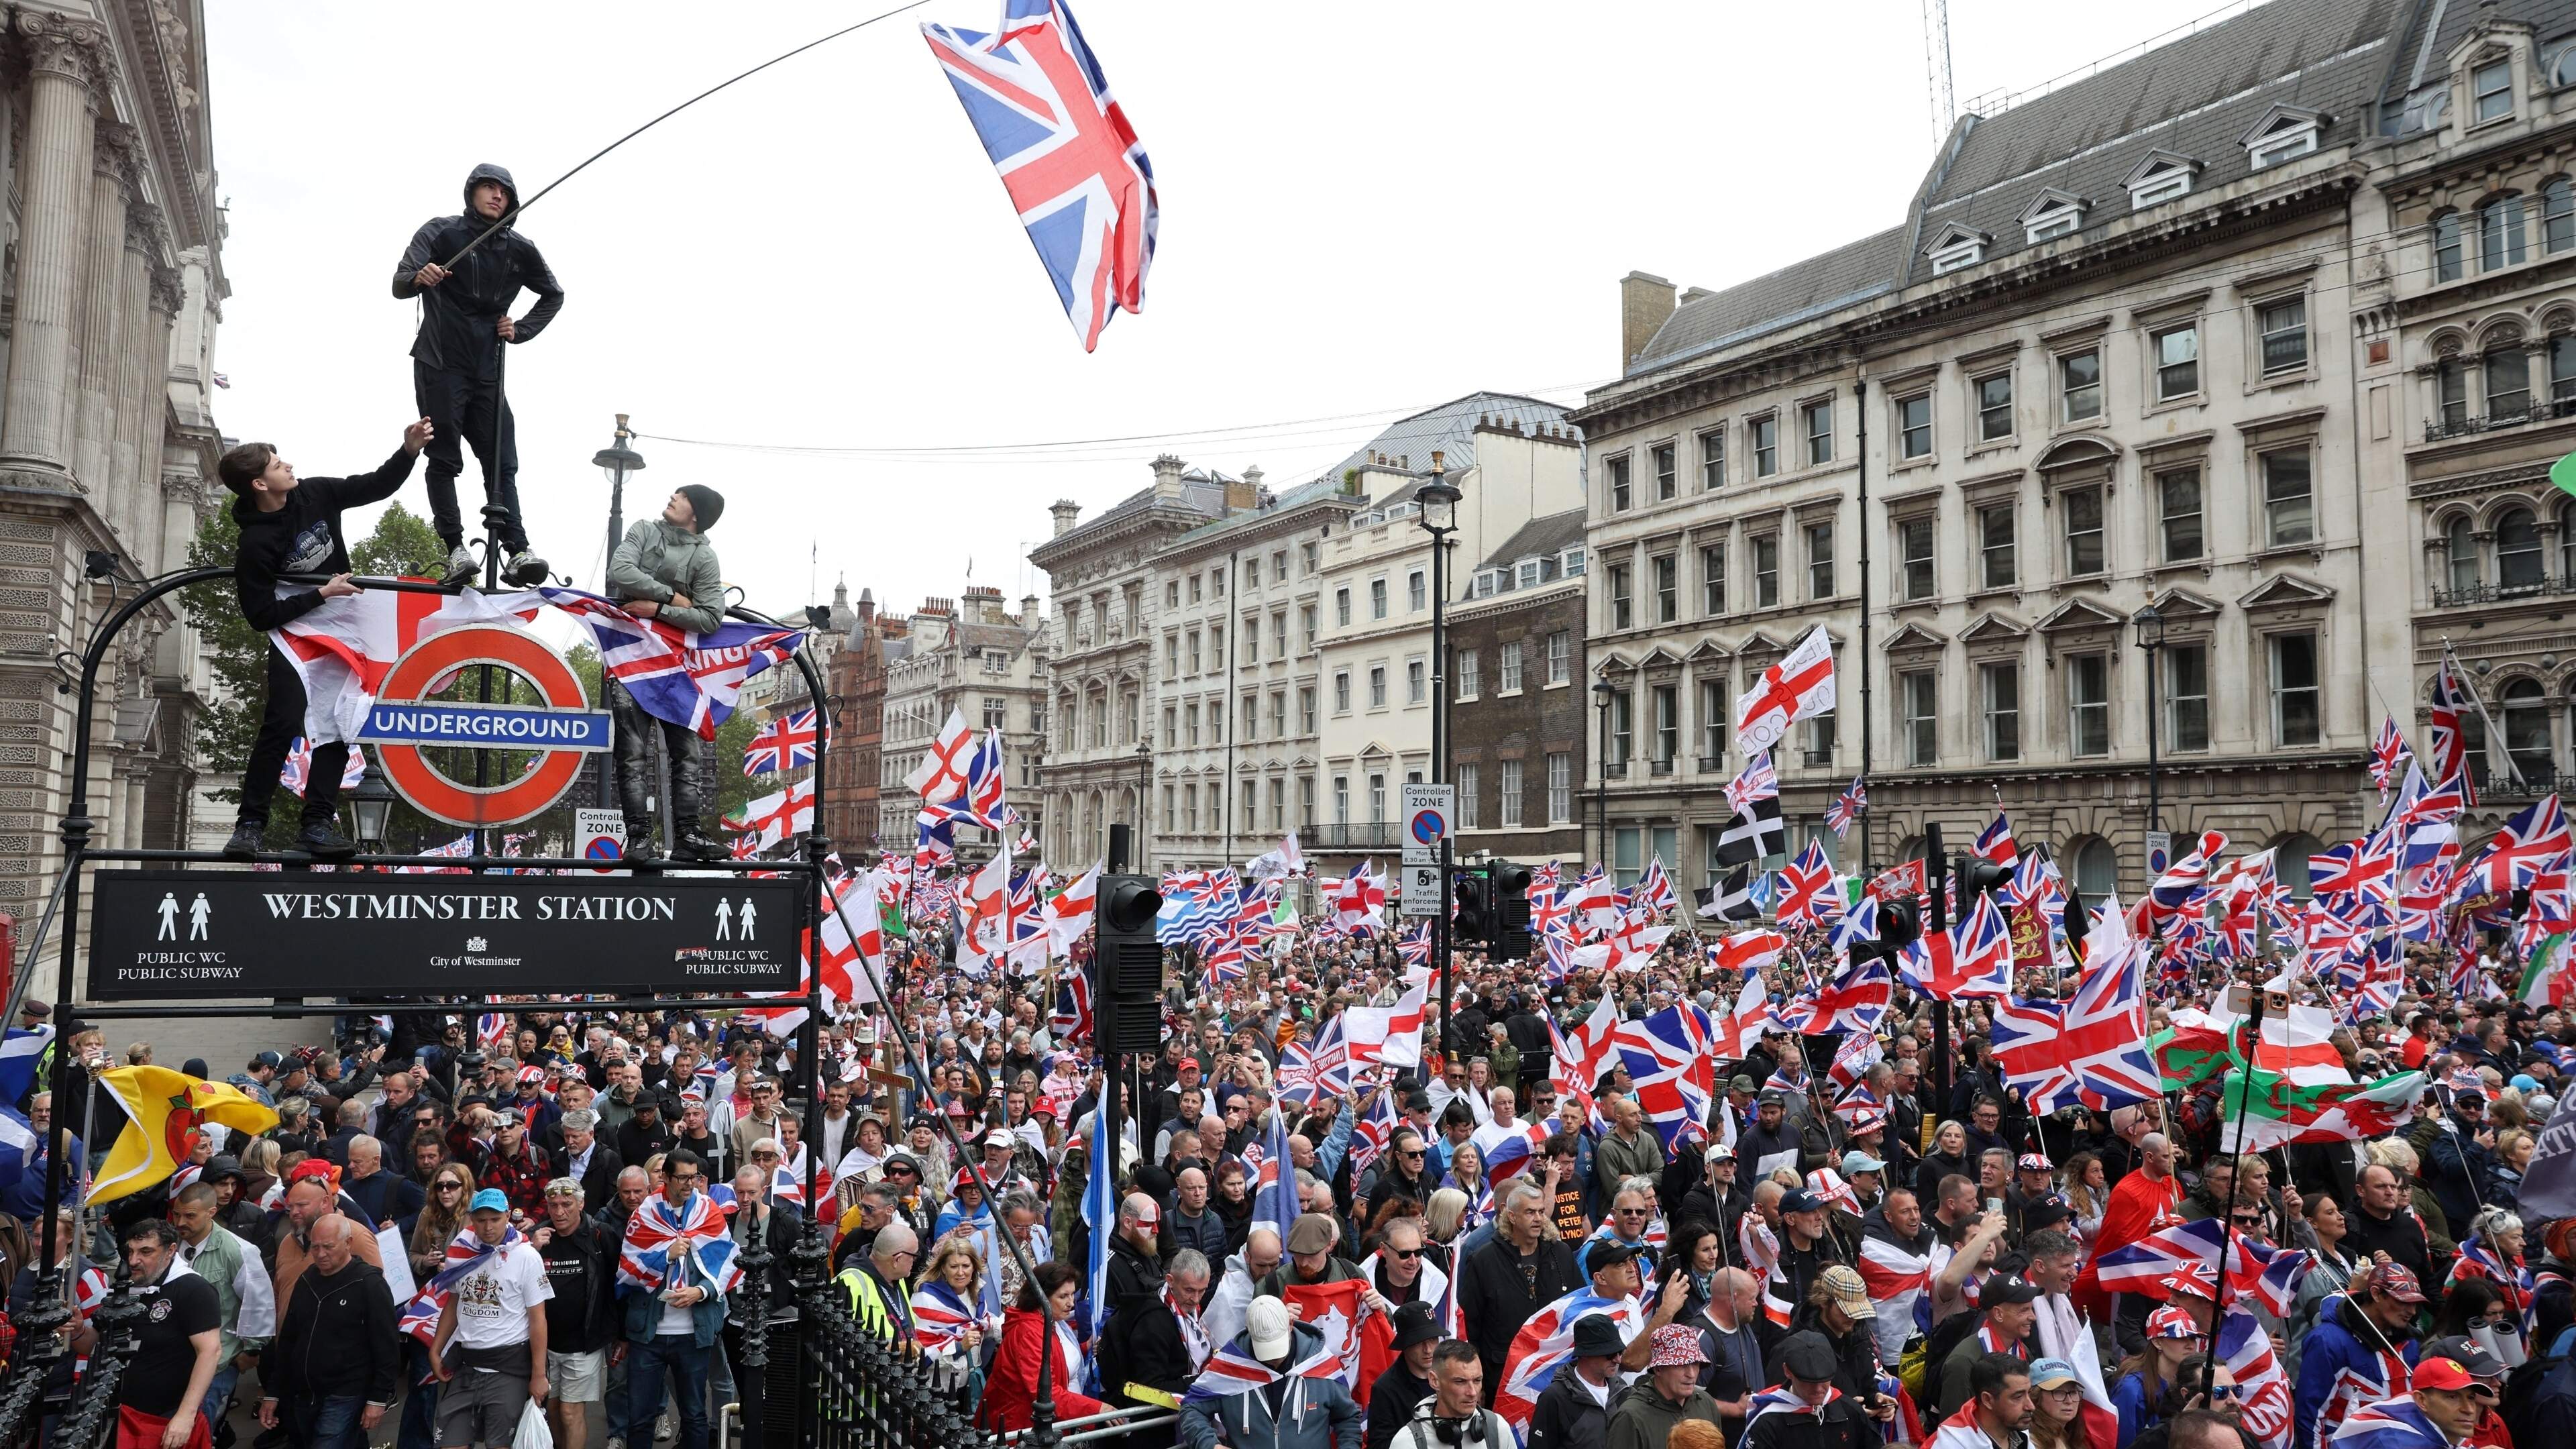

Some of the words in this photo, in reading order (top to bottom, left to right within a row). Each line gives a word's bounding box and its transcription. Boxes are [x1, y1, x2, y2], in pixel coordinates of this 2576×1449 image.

[375, 711, 589, 739] UNDERGROUND
[1406, 787, 1451, 796] Controlled
[1413, 797, 1444, 807] ZONE
[580, 812, 624, 821] Controlle
[586, 823, 623, 834] ZONE
[263, 894, 522, 920] WESTMINSTER
[537, 896, 676, 920] STATION
[137, 952, 196, 964] PUBLIC
[199, 952, 225, 963] WC
[748, 949, 769, 961] WC
[430, 956, 450, 968] City
[451, 956, 462, 966] of
[464, 955, 521, 966] Westminster
[117, 968, 177, 979] PUBLIC
[180, 967, 244, 979] SUBWAY
[686, 965, 731, 974] PUBLIC
[733, 964, 783, 974] SUBWAY
[1554, 1191, 1580, 1204] USTICE
[1560, 1204, 1576, 1215] FOR
[1558, 1216, 1582, 1228] PETER
[1560, 1228, 1584, 1240] LYNCH
[462, 1306, 499, 1317] KINGDOM
[2039, 1361, 2072, 1373] LONDON
